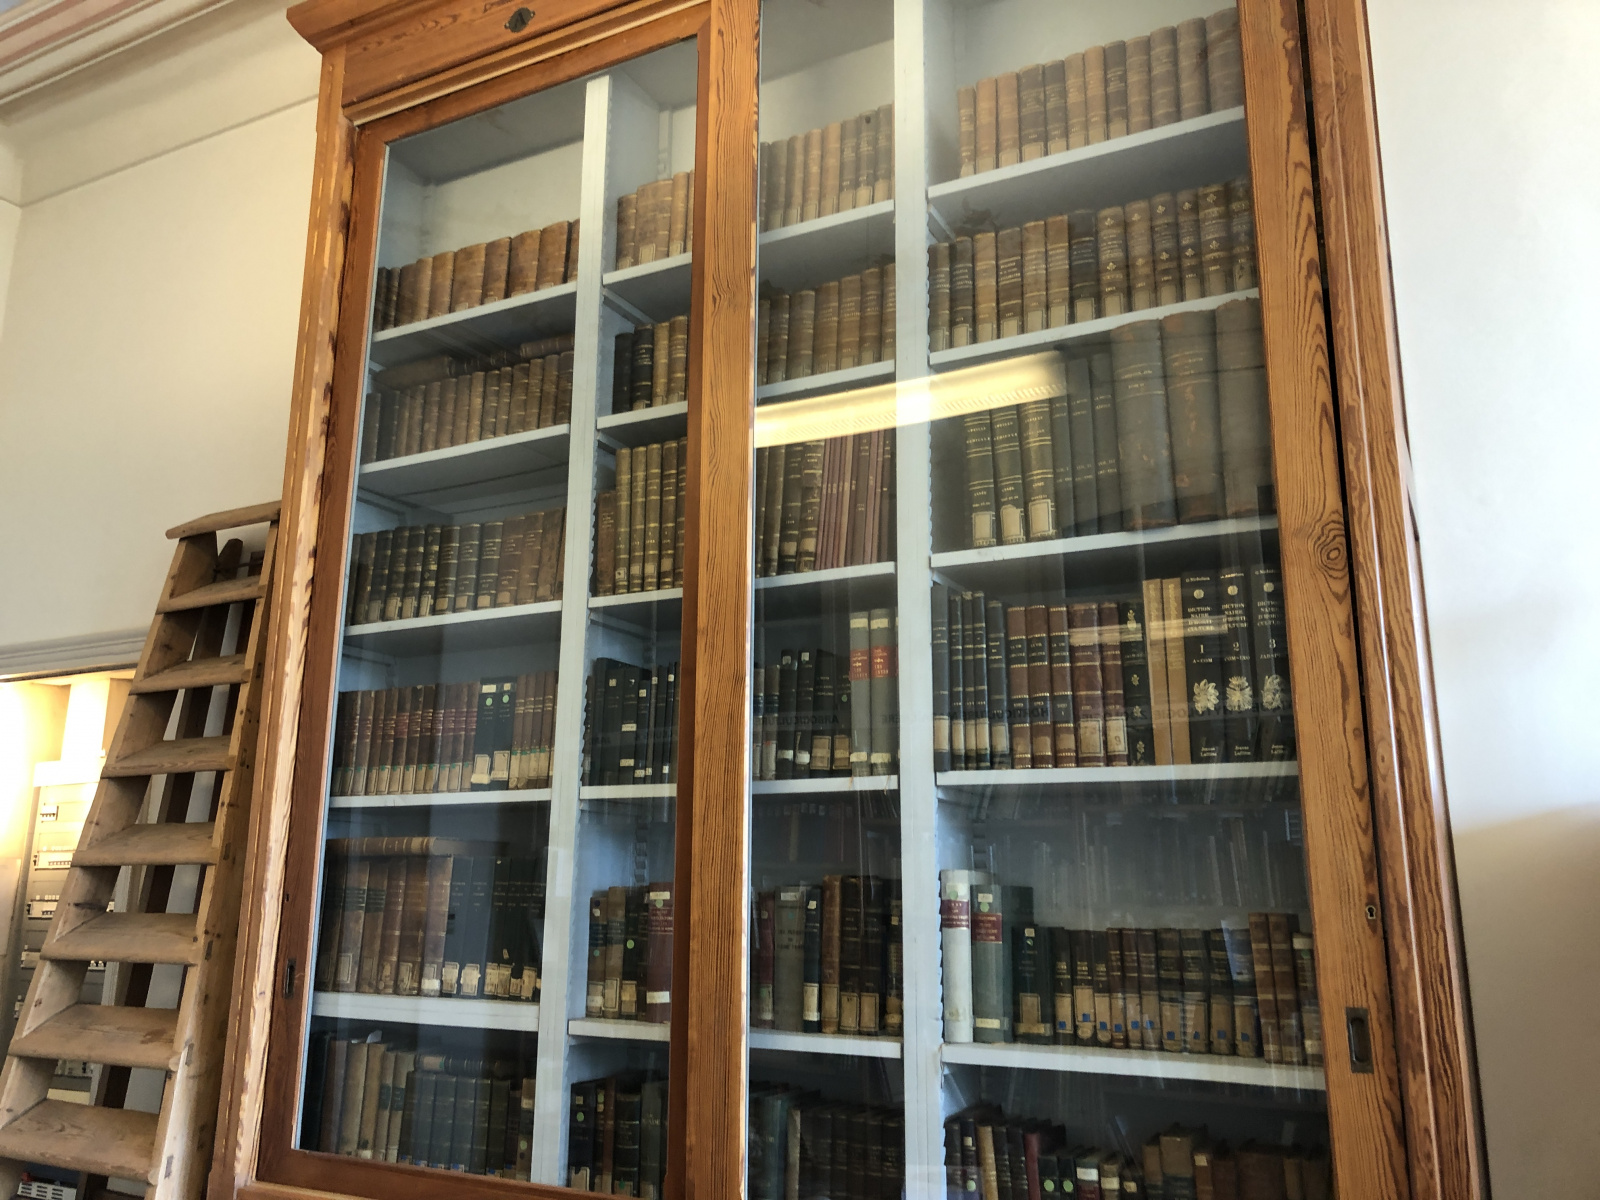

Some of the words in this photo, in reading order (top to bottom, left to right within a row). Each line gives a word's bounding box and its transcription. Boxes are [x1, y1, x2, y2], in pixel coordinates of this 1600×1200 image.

[1199, 644, 1204, 654] 1
[1232, 641, 1240, 652] 2
[1268, 638, 1277, 649] 3
